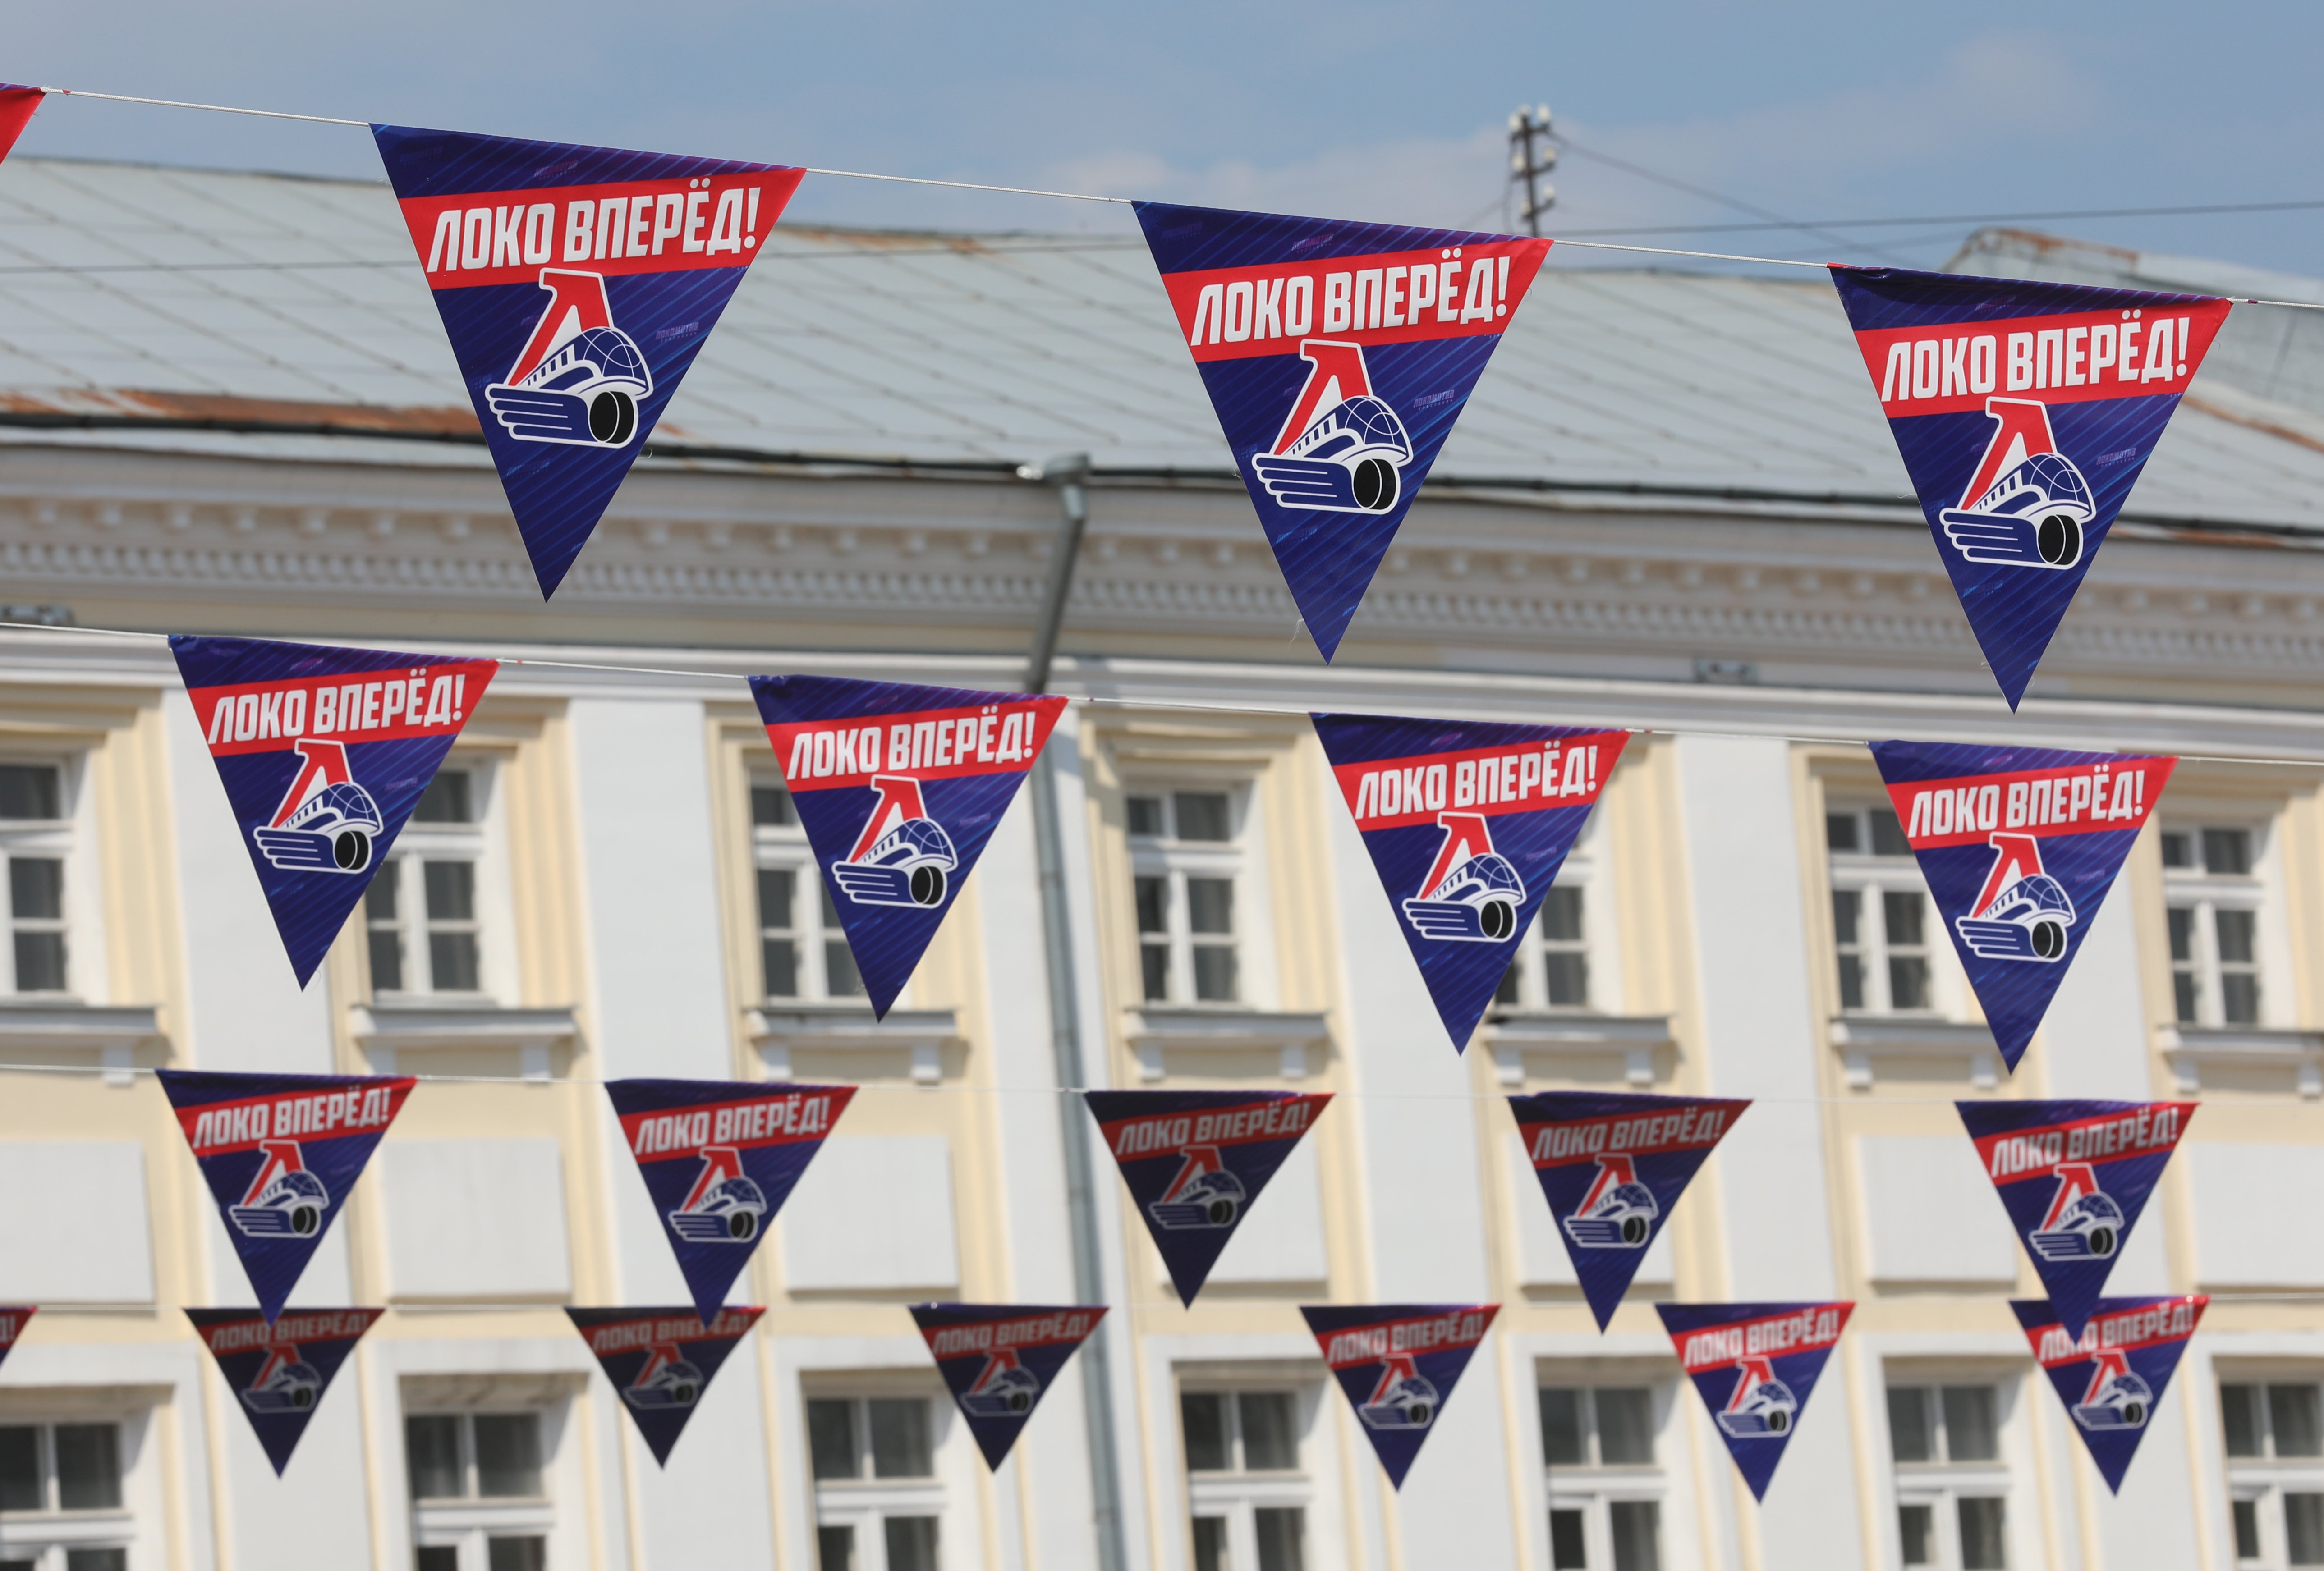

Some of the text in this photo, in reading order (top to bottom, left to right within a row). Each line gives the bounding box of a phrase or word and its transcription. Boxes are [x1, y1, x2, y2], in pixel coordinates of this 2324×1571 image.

[427, 179, 760, 272] ЛОКО ВПЕРЁД!
[1191, 248, 1510, 346] ЛОКО ВПЕРЁД!
[1881, 309, 2190, 402] ЛОКО ВПЕРЁД!
[208, 669, 465, 744] ЛОКО ВПЕРЁД!
[787, 706, 1036, 780] ЛОКО ВПЕРЁД!
[1355, 740, 1598, 820] ЛОКО ВПЕРЁД!
[1908, 765, 2145, 838] ЛОКО ВПЕРЁД!
[194, 1085, 390, 1149] ЛОКО ВПЕРЁД!
[636, 1093, 830, 1155] ЛОКО ВПЕРЁД!
[1117, 1100, 1311, 1156] ЛОКО ВПЕРЁД!
[1534, 1107, 1726, 1160] ЛОКО ВПЕРЁД!
[1992, 1107, 2178, 1178] ЛОКО ВПЕРЁД!
[211, 1310, 369, 1350] ЛОКО ВПЕРЁД!
[592, 1311, 750, 1351] ЛОКО ВПЕЁД!
[933, 1312, 1090, 1356] ЛОКО ВПЕРЁД!
[1329, 1311, 1484, 1364] ЛОКО ВПЕРЁД!
[1685, 1309, 1839, 1368] ЛОКО ВПЕРЁД!
[2101, 1301, 2194, 1347] ВПЕРЁД!
